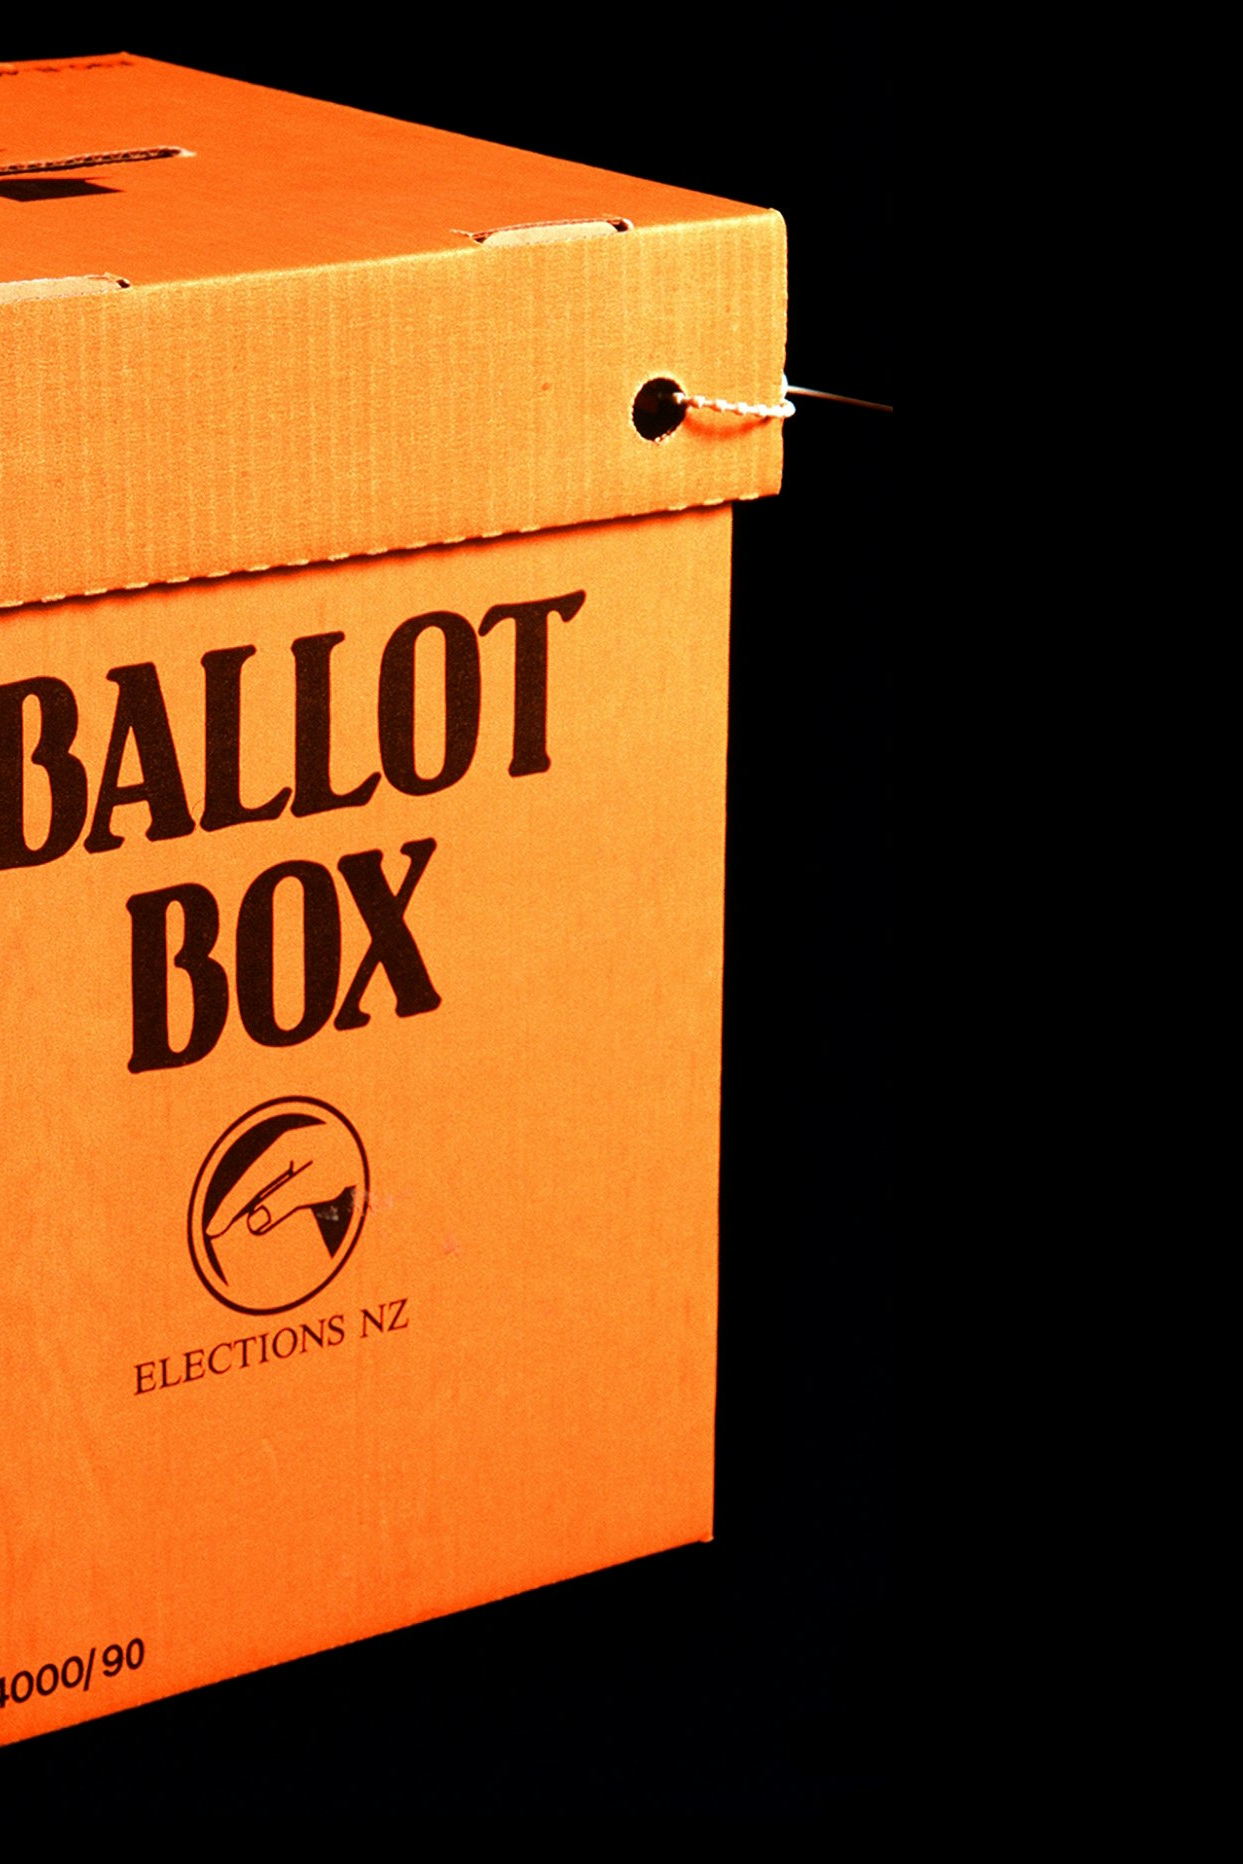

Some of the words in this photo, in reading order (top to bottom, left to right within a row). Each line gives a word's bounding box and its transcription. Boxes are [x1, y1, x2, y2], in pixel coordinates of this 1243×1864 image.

[125, 837, 443, 1074] BOX
[133, 1314, 346, 1396] ELECTIONS
[359, 1297, 410, 1339] NZ
